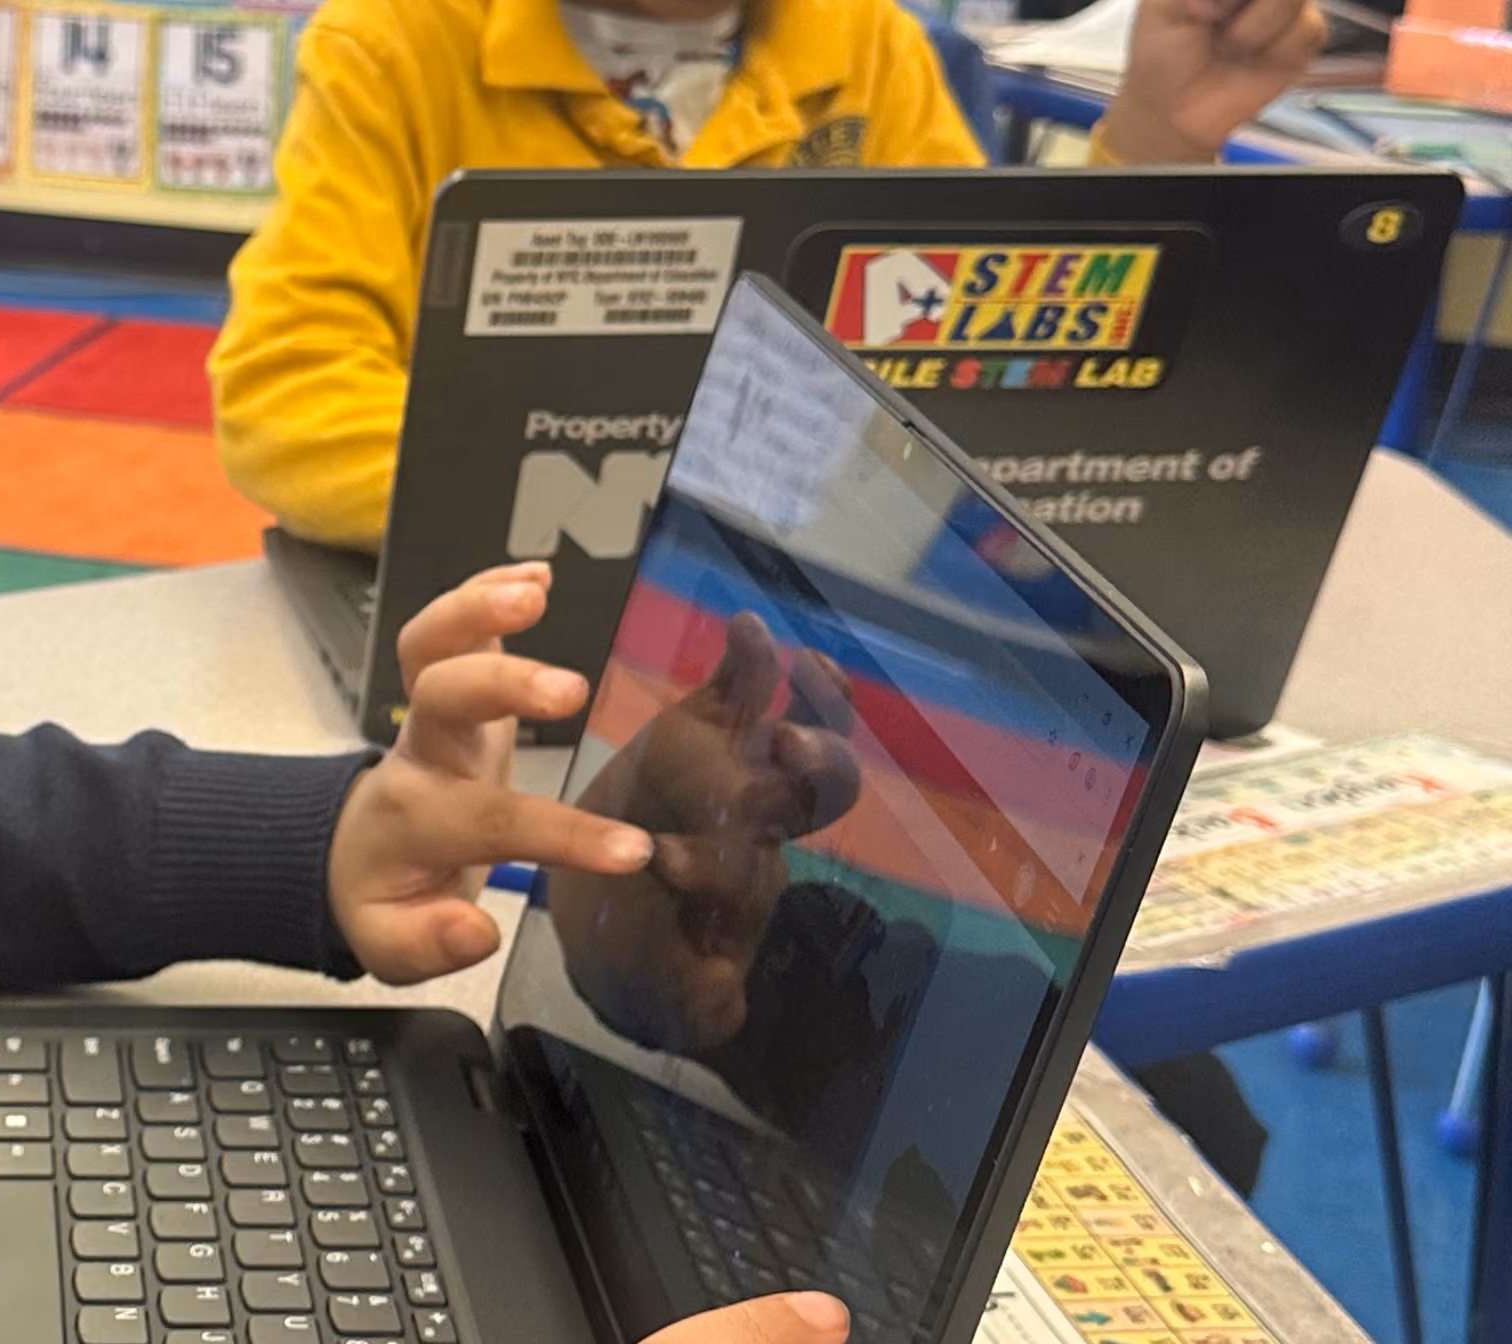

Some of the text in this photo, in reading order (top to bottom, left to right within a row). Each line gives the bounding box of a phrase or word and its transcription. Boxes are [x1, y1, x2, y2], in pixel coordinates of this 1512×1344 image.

[62, 17, 111, 76] 14
[194, 24, 244, 86] 15
[1366, 208, 1404, 244] 8
[964, 253, 1138, 298] STEM
[951, 357, 1071, 389] STEM
[1074, 357, 1164, 388] LAB
[524, 409, 682, 447] Property
[1207, 446, 1262, 481] of
[96, 1108, 120, 1118] Z
[174, 1128, 198, 1138] S
[254, 1152, 278, 1162] E
[179, 1164, 202, 1176] D
[103, 1182, 126, 1194] C
[185, 1204, 208, 1213] F
[318, 1212, 340, 1221] 5
[108, 1222, 128, 1234] V
[270, 1232, 292, 1242] T
[190, 1244, 213, 1257] G
[326, 1252, 348, 1262] 6
[110, 1264, 134, 1275] B
[278, 1274, 299, 1285] Y
[197, 1287, 218, 1298] H
[337, 1296, 359, 1305] 7
[114, 1308, 136, 1320] N
[285, 1317, 308, 1328] U
[202, 1332, 226, 1341] J
